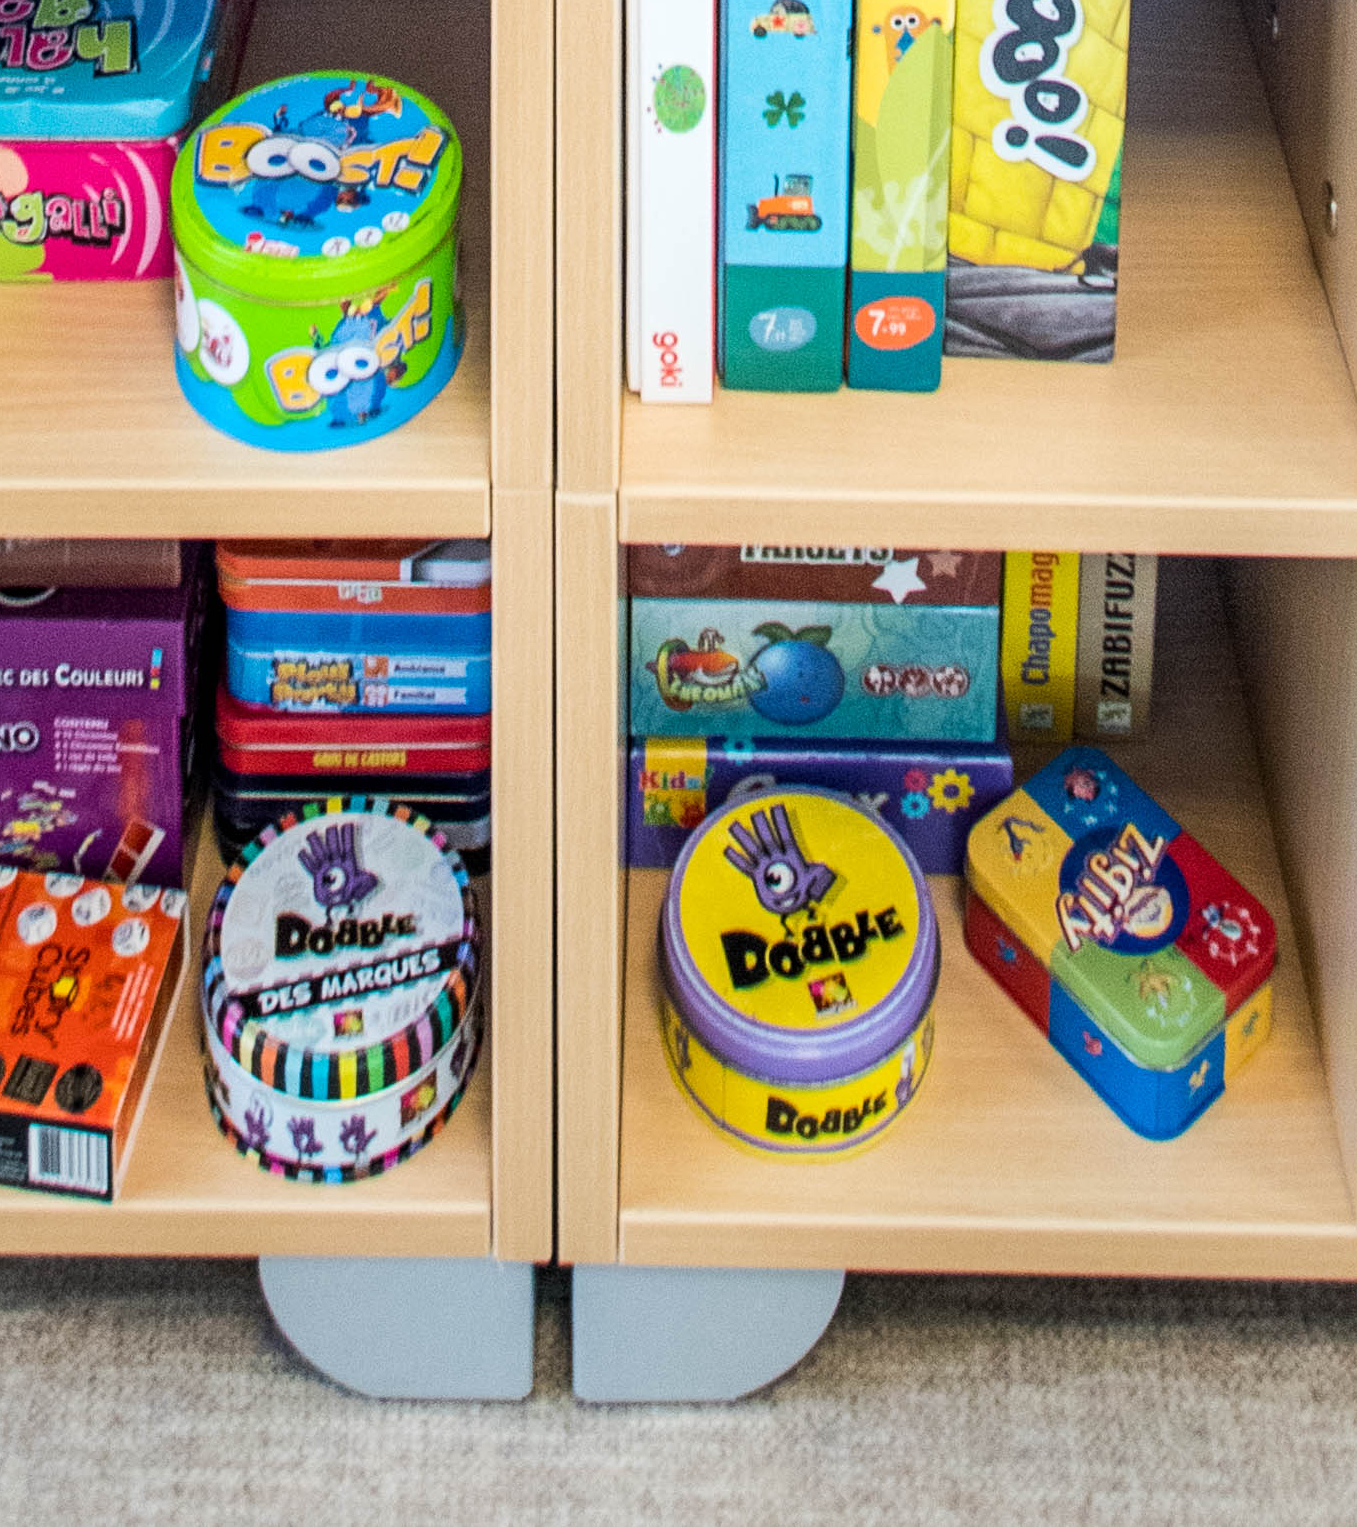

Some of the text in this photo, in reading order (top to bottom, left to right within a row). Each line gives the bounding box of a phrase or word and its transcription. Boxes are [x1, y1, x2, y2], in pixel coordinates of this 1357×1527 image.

[652, 331, 683, 389] goki
[720, 905, 906, 992] DOBBLE
[257, 951, 441, 1017] DES MARQUES
[763, 1091, 888, 1140] DOBBLE
